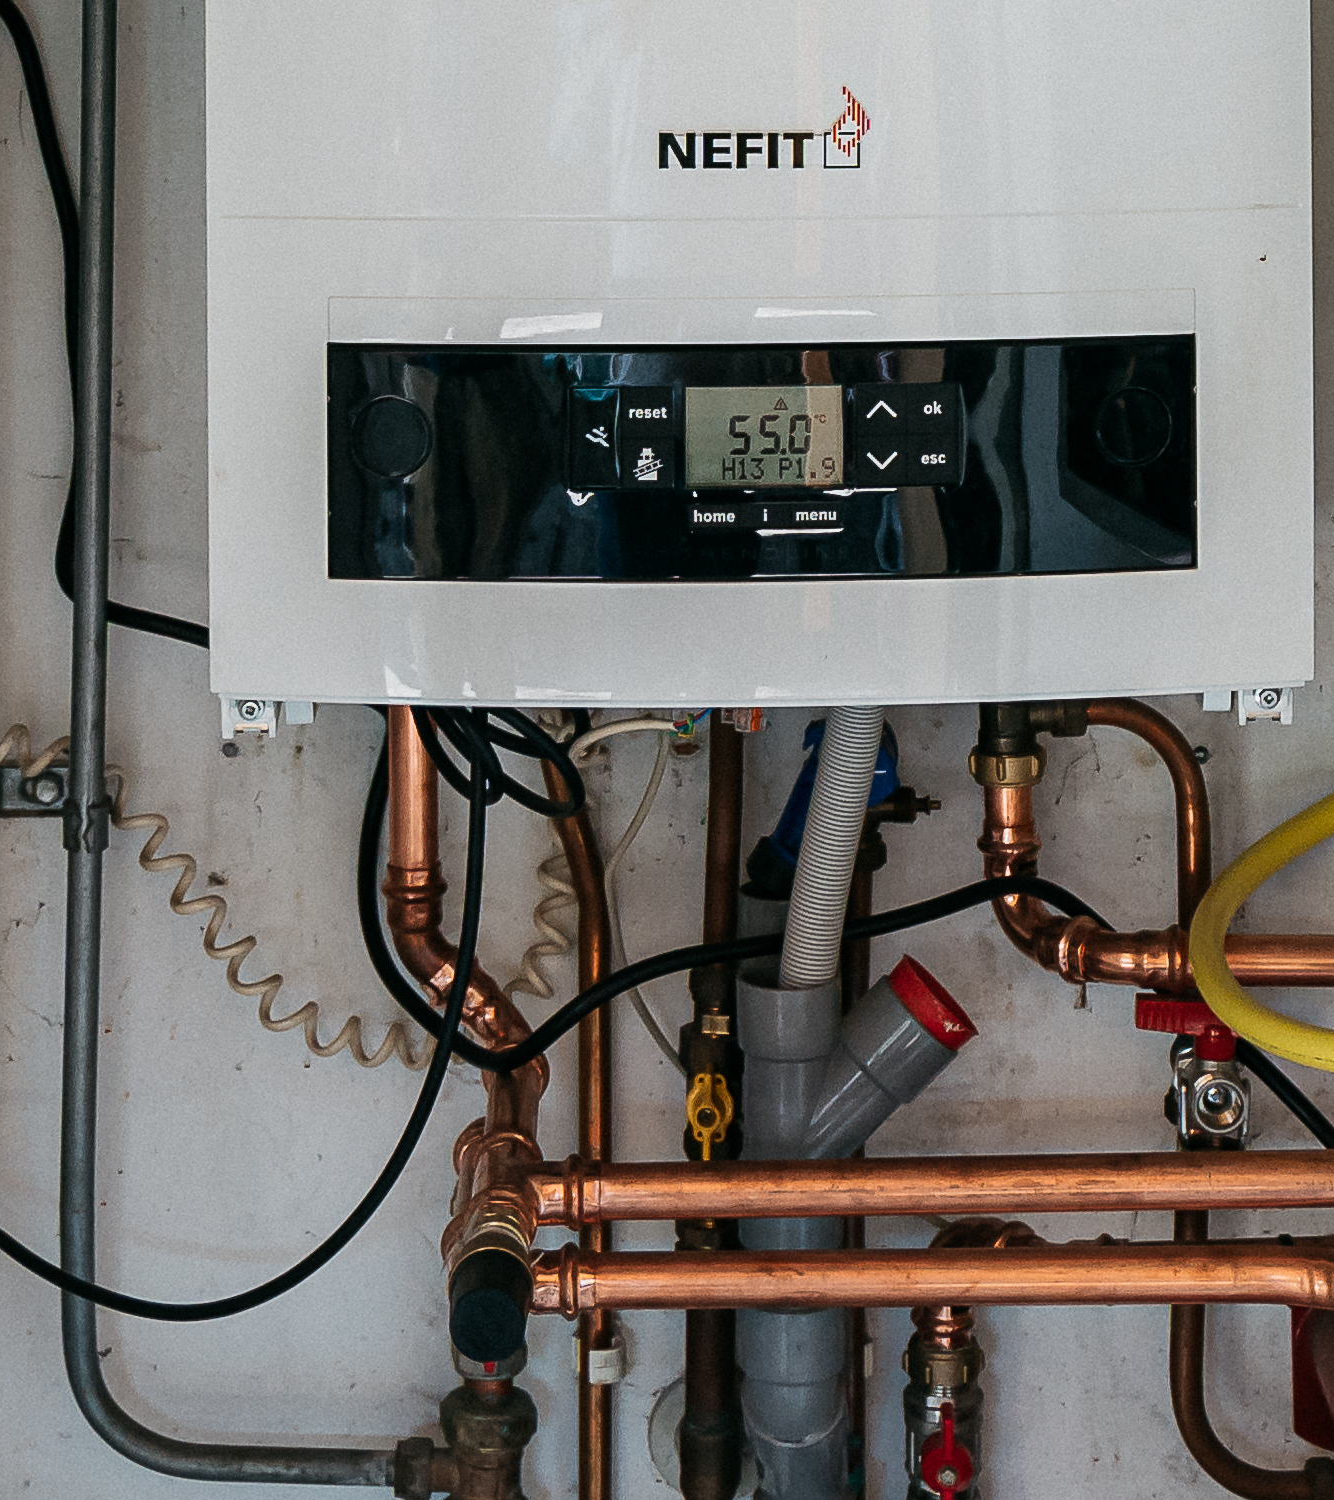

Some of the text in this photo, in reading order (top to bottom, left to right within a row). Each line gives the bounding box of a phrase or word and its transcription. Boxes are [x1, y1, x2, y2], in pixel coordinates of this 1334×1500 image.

[658, 132, 815, 169] NEFIT
[628, 401, 942, 419] reset ok
[728, 414, 813, 455] 55.0
[721, 456, 836, 480] H13 P1.9
[921, 453, 946, 465] esc
[693, 508, 837, 523] home i menu
